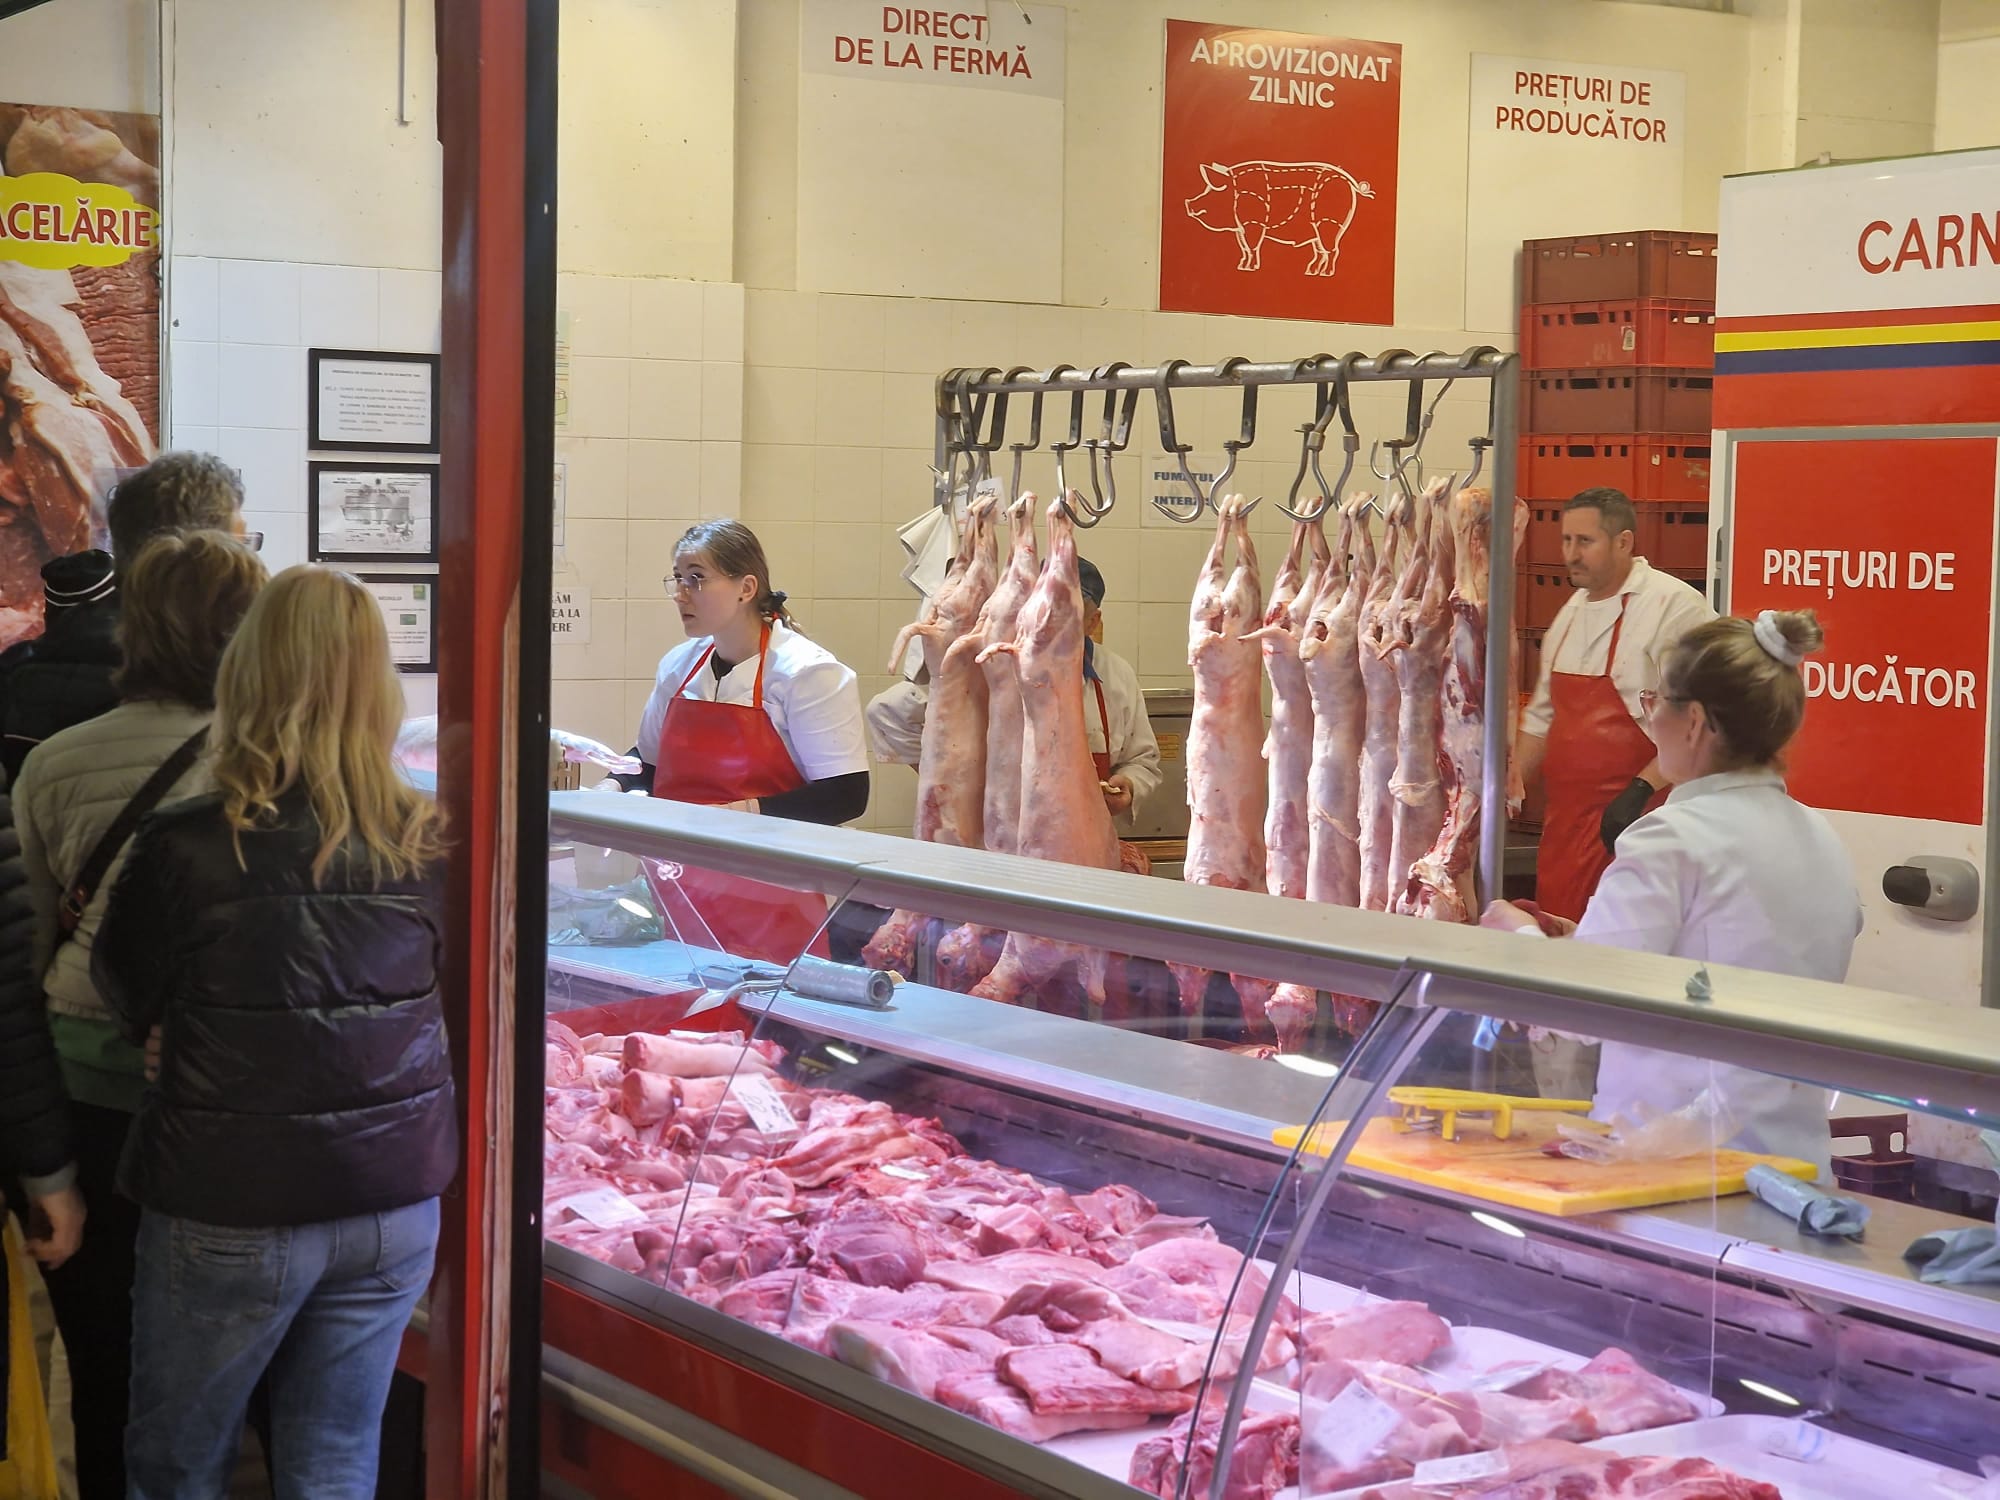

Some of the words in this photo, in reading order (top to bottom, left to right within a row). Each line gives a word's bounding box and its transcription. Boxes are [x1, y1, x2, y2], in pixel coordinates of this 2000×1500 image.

[883, 6, 987, 41] DIRECT
[834, 36, 873, 65] DE
[884, 40, 923, 70] LA
[933, 45, 1032, 79] FERMĂ
[1190, 38, 1393, 82] APROVIZIONAT
[1248, 75, 1335, 108] ZILNIC
[1515, 71, 1612, 107] PREȚURI
[1620, 81, 1651, 106] DE
[1496, 106, 1666, 143] PRODUCĂTOR
[1858, 210, 2000, 274] CARN
[1154, 471, 1215, 483] FUMTUL
[1154, 495, 1212, 507] INTERZS
[1763, 549, 1897, 600] PREȚURI
[1908, 552, 1955, 591] DE
[552, 622, 573, 633] ERE
[567, 608, 581, 618] LA
[1803, 655, 1976, 709] DUCĂTOR
